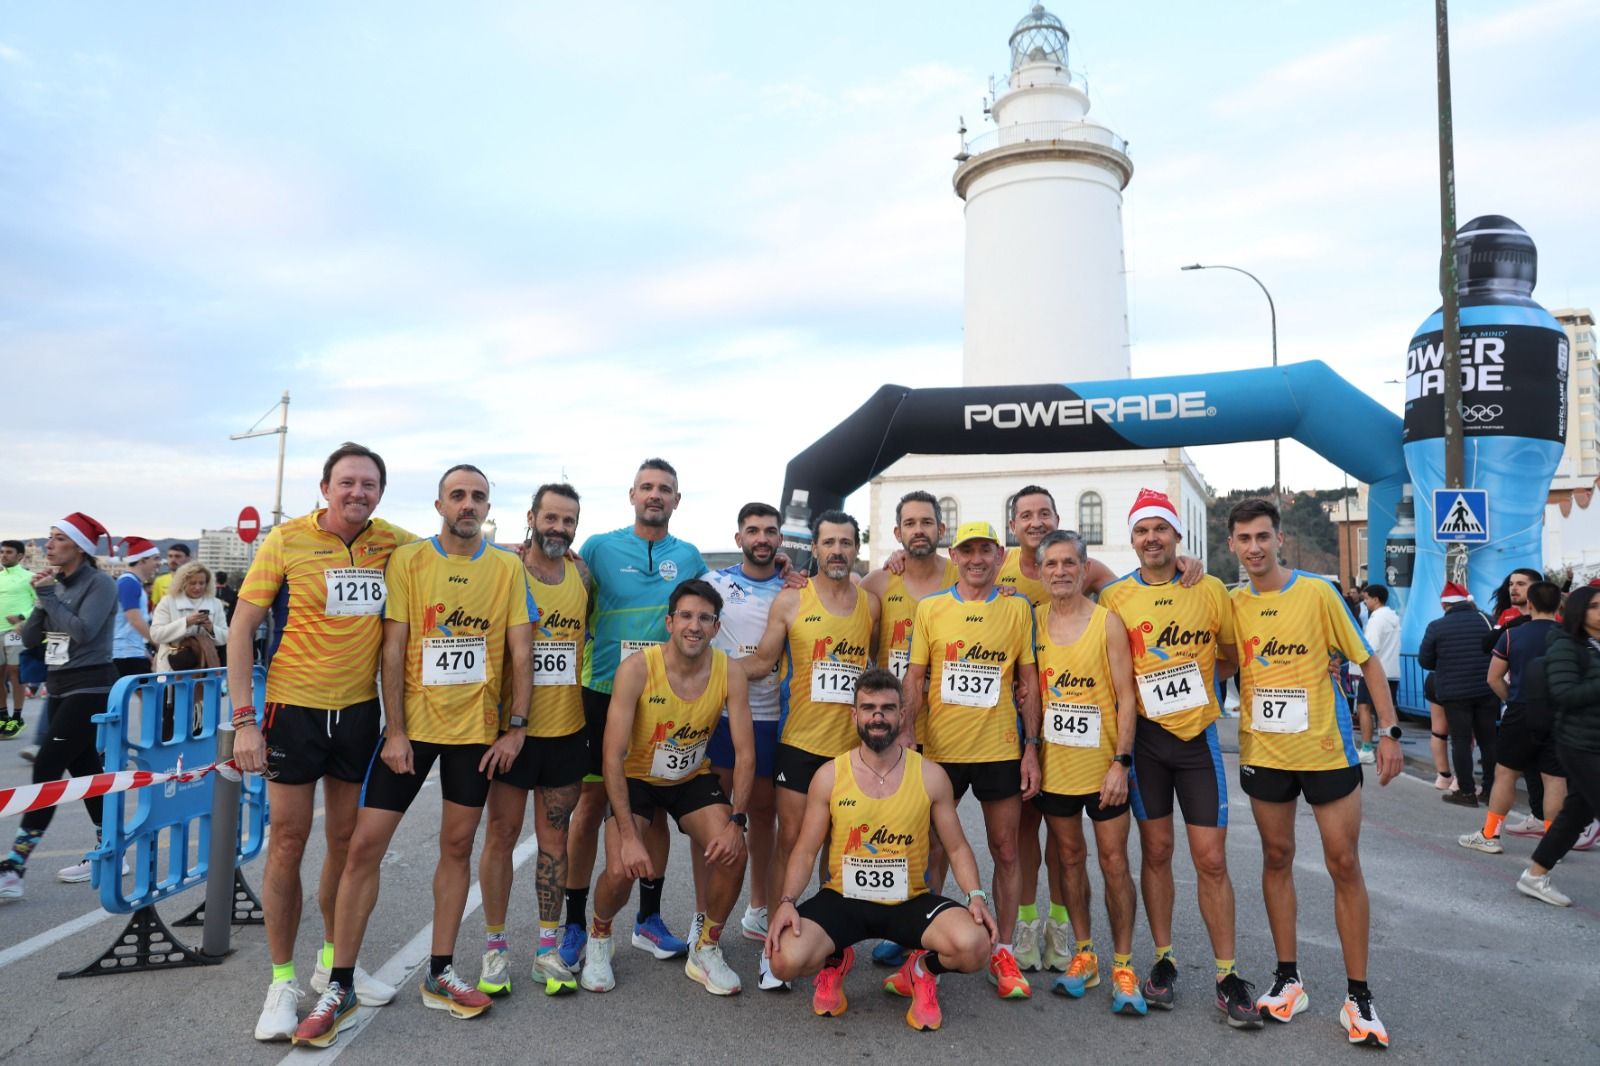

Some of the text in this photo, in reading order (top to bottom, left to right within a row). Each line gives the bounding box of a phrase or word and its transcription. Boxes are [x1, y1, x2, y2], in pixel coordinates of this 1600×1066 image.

[1407, 338, 1505, 374] OWER
[449, 575, 469, 584] vive
[334, 581, 382, 601] 1218
[887, 594, 903, 602] vive
[1154, 597, 1174, 606] vive
[444, 606, 491, 631] Álora
[543, 609, 581, 630] Álora
[805, 613, 821, 622] vive
[965, 615, 984, 623] vive
[1261, 607, 1279, 616] vive
[1156, 620, 1212, 647] Álora
[965, 642, 1008, 662] Álora
[1261, 637, 1309, 657] Álora
[436, 651, 475, 671] 470
[533, 654, 567, 672] 566
[947, 674, 994, 694] 1337
[1055, 669, 1096, 688] Álora
[1153, 677, 1191, 702] 144
[649, 695, 667, 705] vive
[1263, 700, 1287, 719] 87
[1053, 714, 1088, 734] 845
[666, 751, 697, 769] 351
[839, 798, 857, 807] vive
[869, 825, 914, 846] Álora
[855, 870, 895, 888] 638
